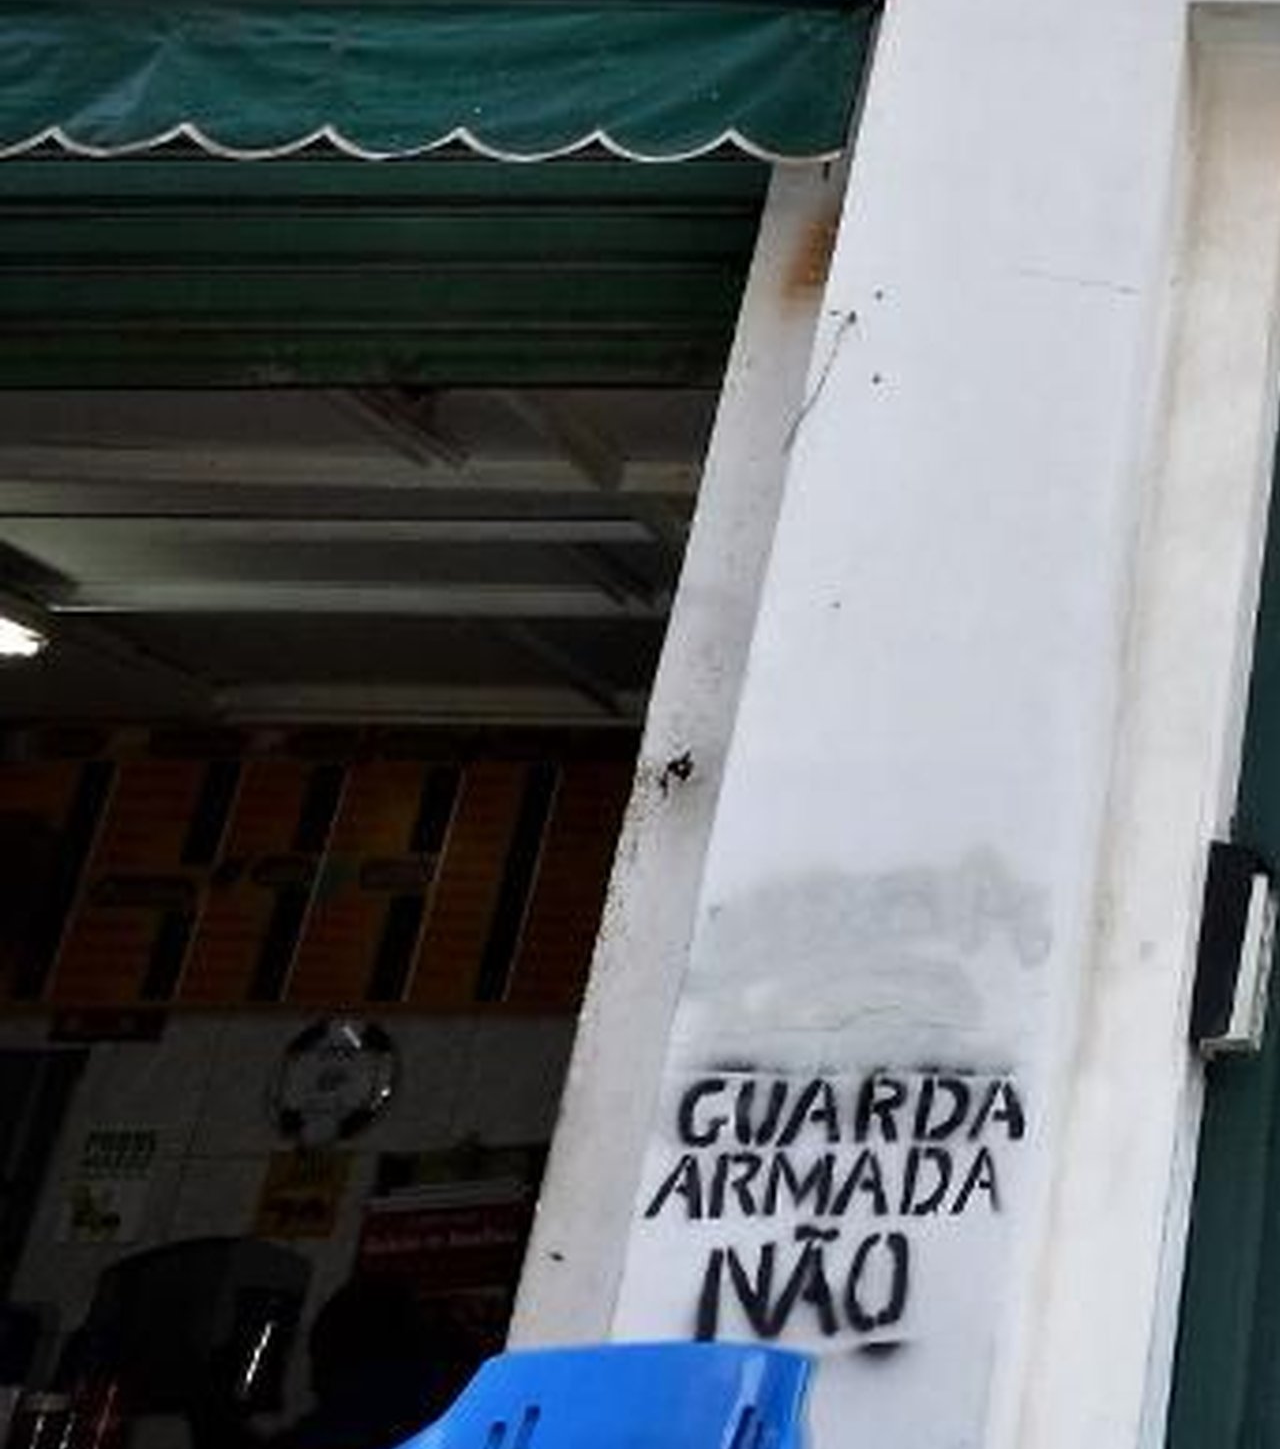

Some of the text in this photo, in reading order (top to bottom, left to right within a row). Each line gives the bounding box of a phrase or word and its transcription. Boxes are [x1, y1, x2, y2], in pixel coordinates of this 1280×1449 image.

[677, 1077, 1026, 1148] GUARDA
[644, 1146, 1000, 1220] ARMADA
[692, 1224, 910, 1342] NÃO
